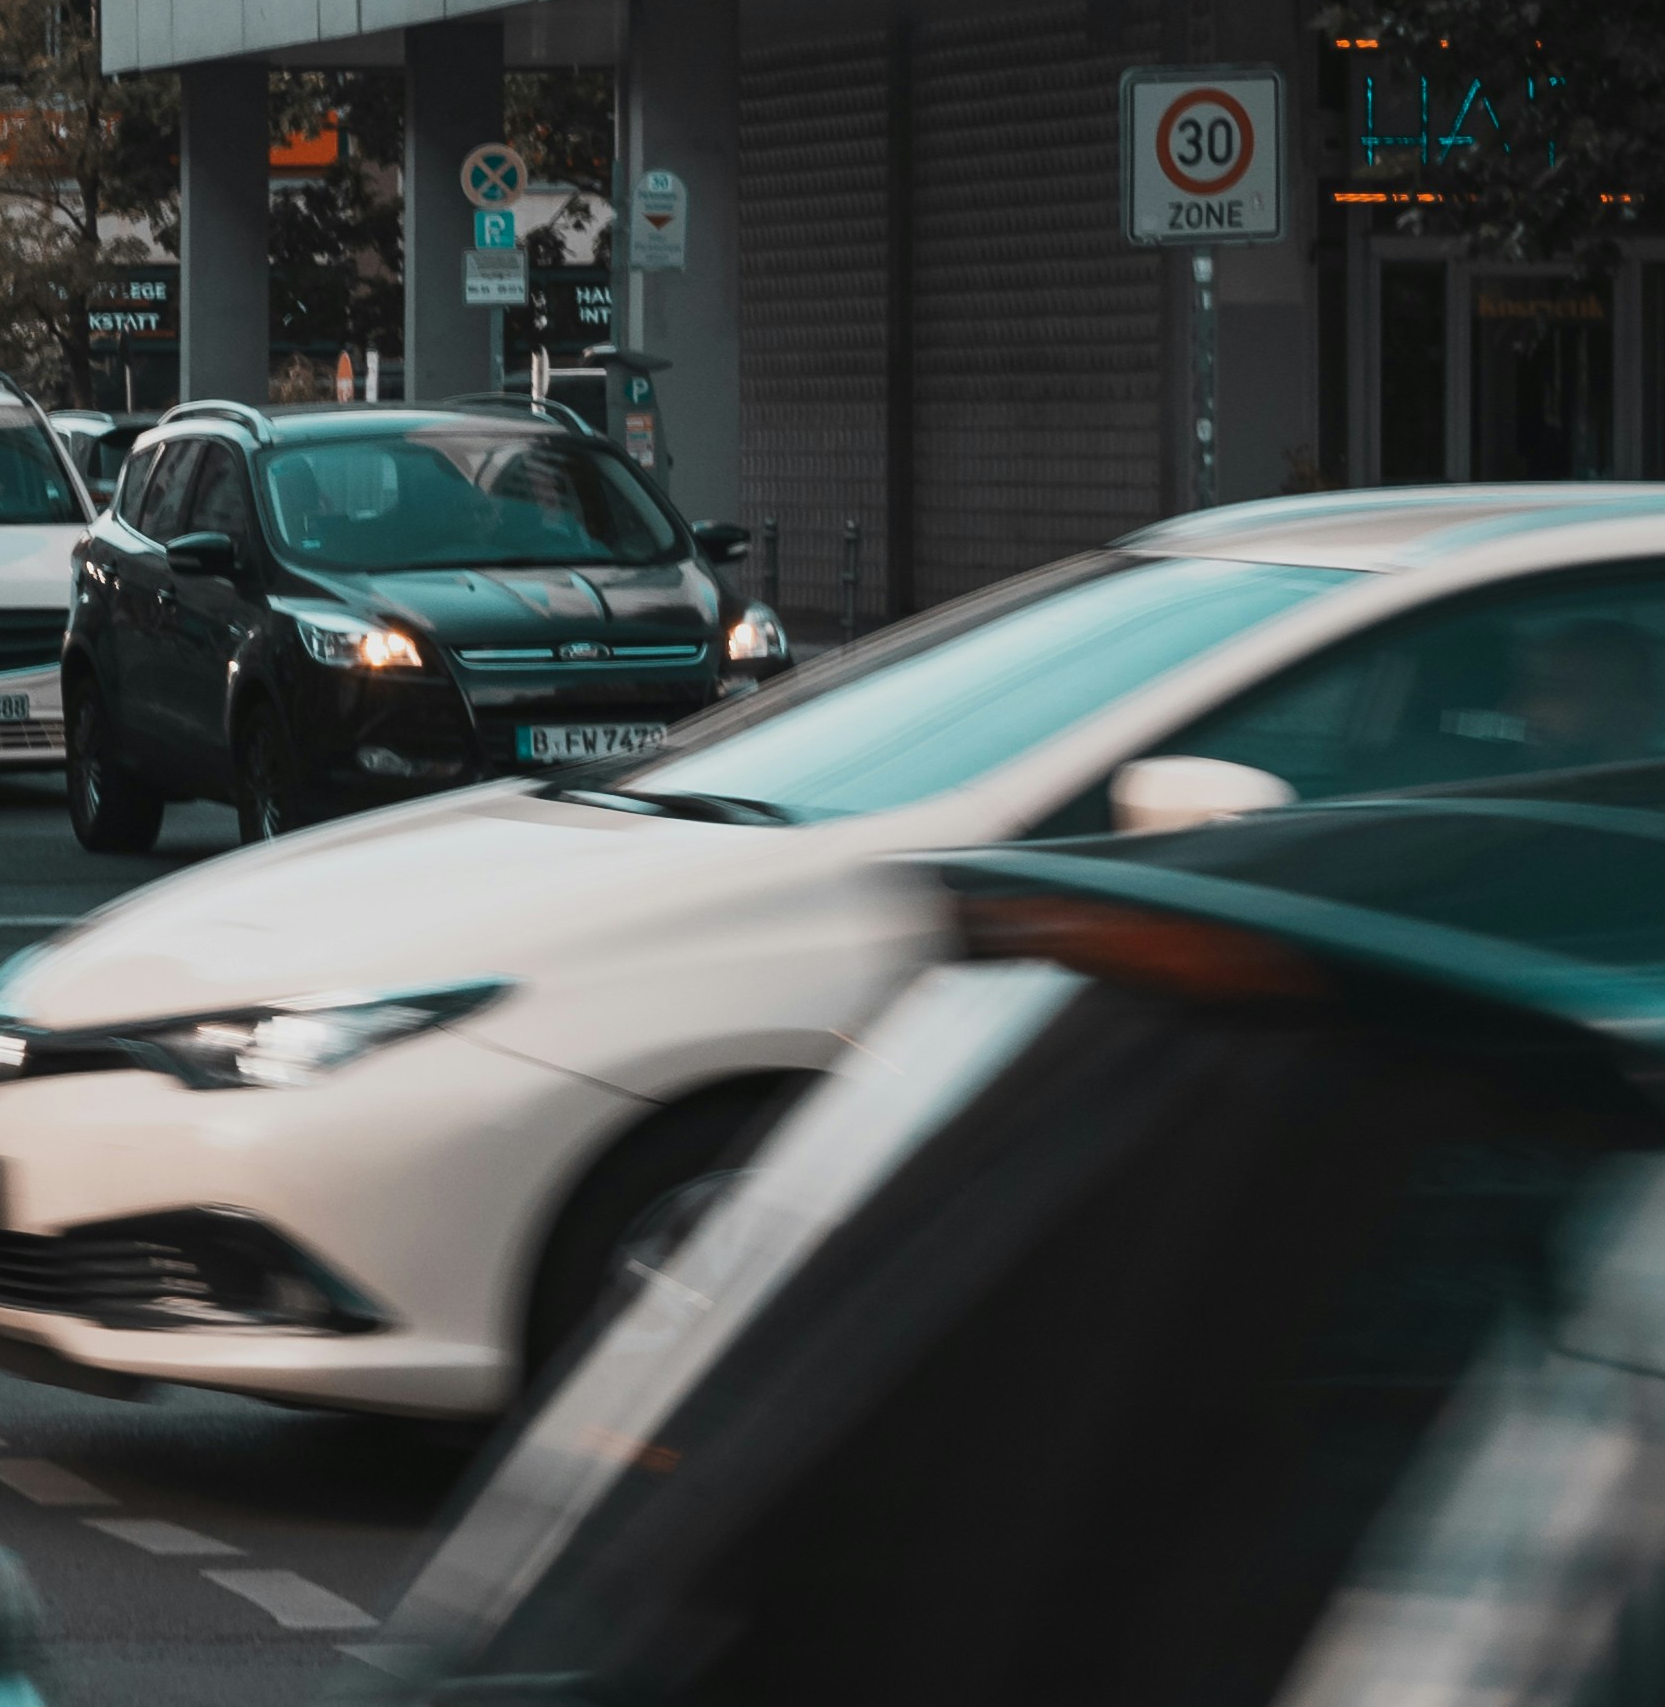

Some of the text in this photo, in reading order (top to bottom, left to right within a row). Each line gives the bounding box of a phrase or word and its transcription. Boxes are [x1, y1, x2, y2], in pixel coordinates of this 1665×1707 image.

[1177, 118, 1233, 167] 30
[1168, 200, 1244, 230] ZONE
[88, 313, 160, 331] KSTATT
[533, 728, 548, 755] B
